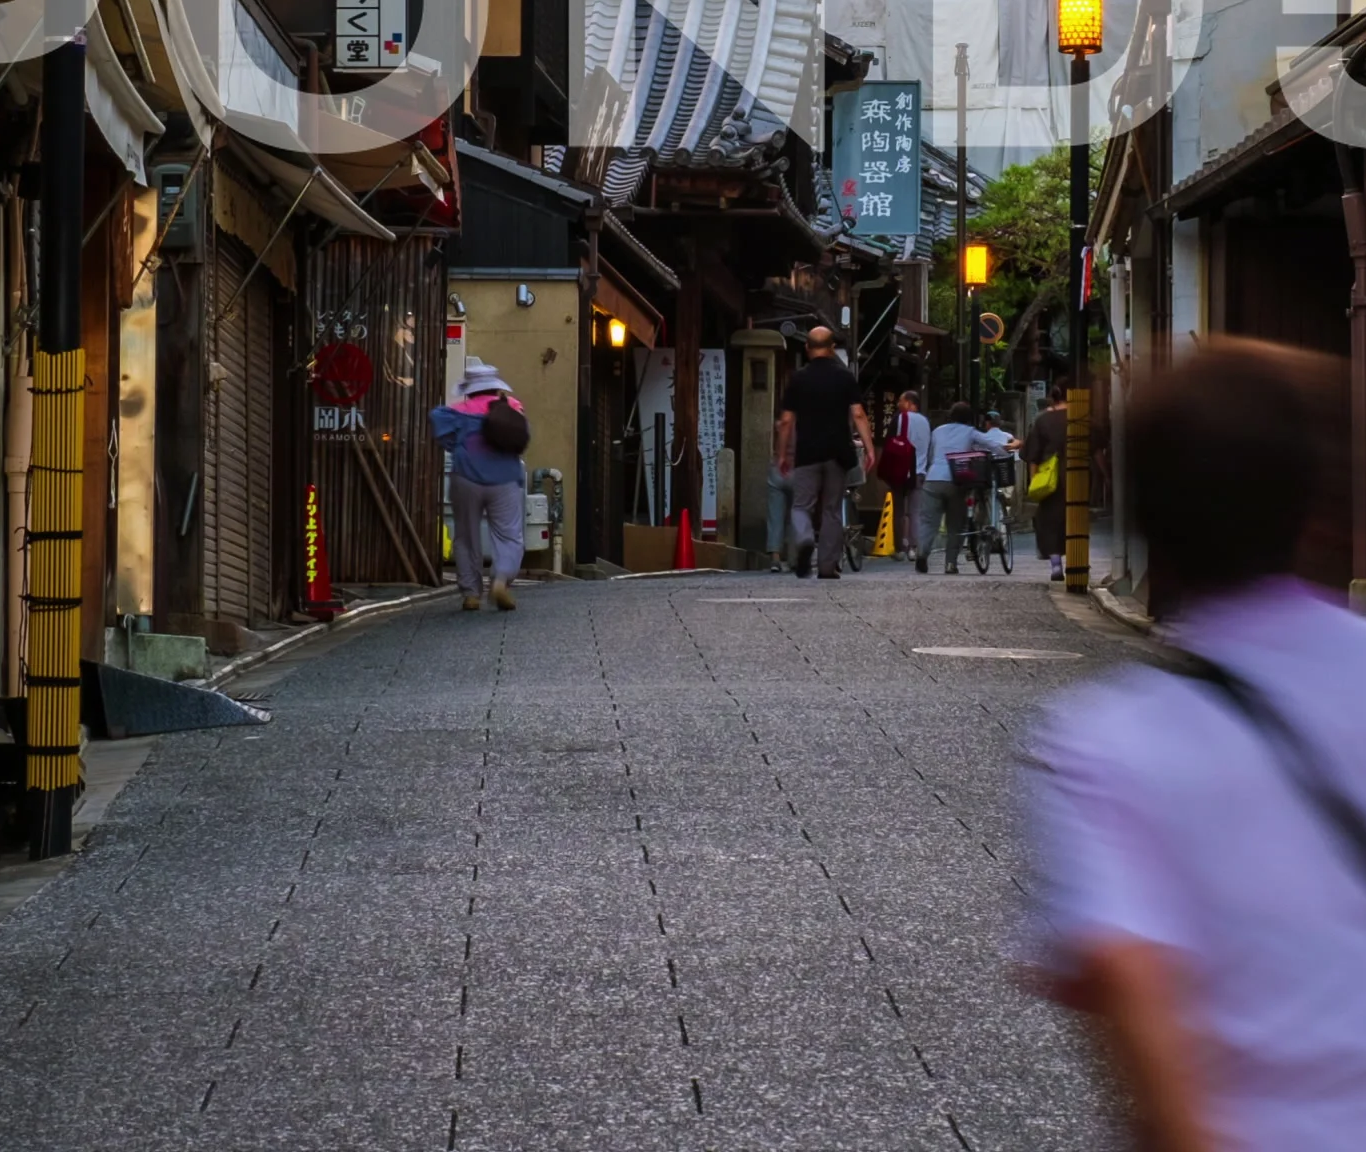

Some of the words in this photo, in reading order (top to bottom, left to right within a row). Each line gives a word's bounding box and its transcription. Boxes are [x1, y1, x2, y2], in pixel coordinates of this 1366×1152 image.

[894, 91, 913, 174] 創作陶房
[314, 433, 365, 442] OKAMOTO
